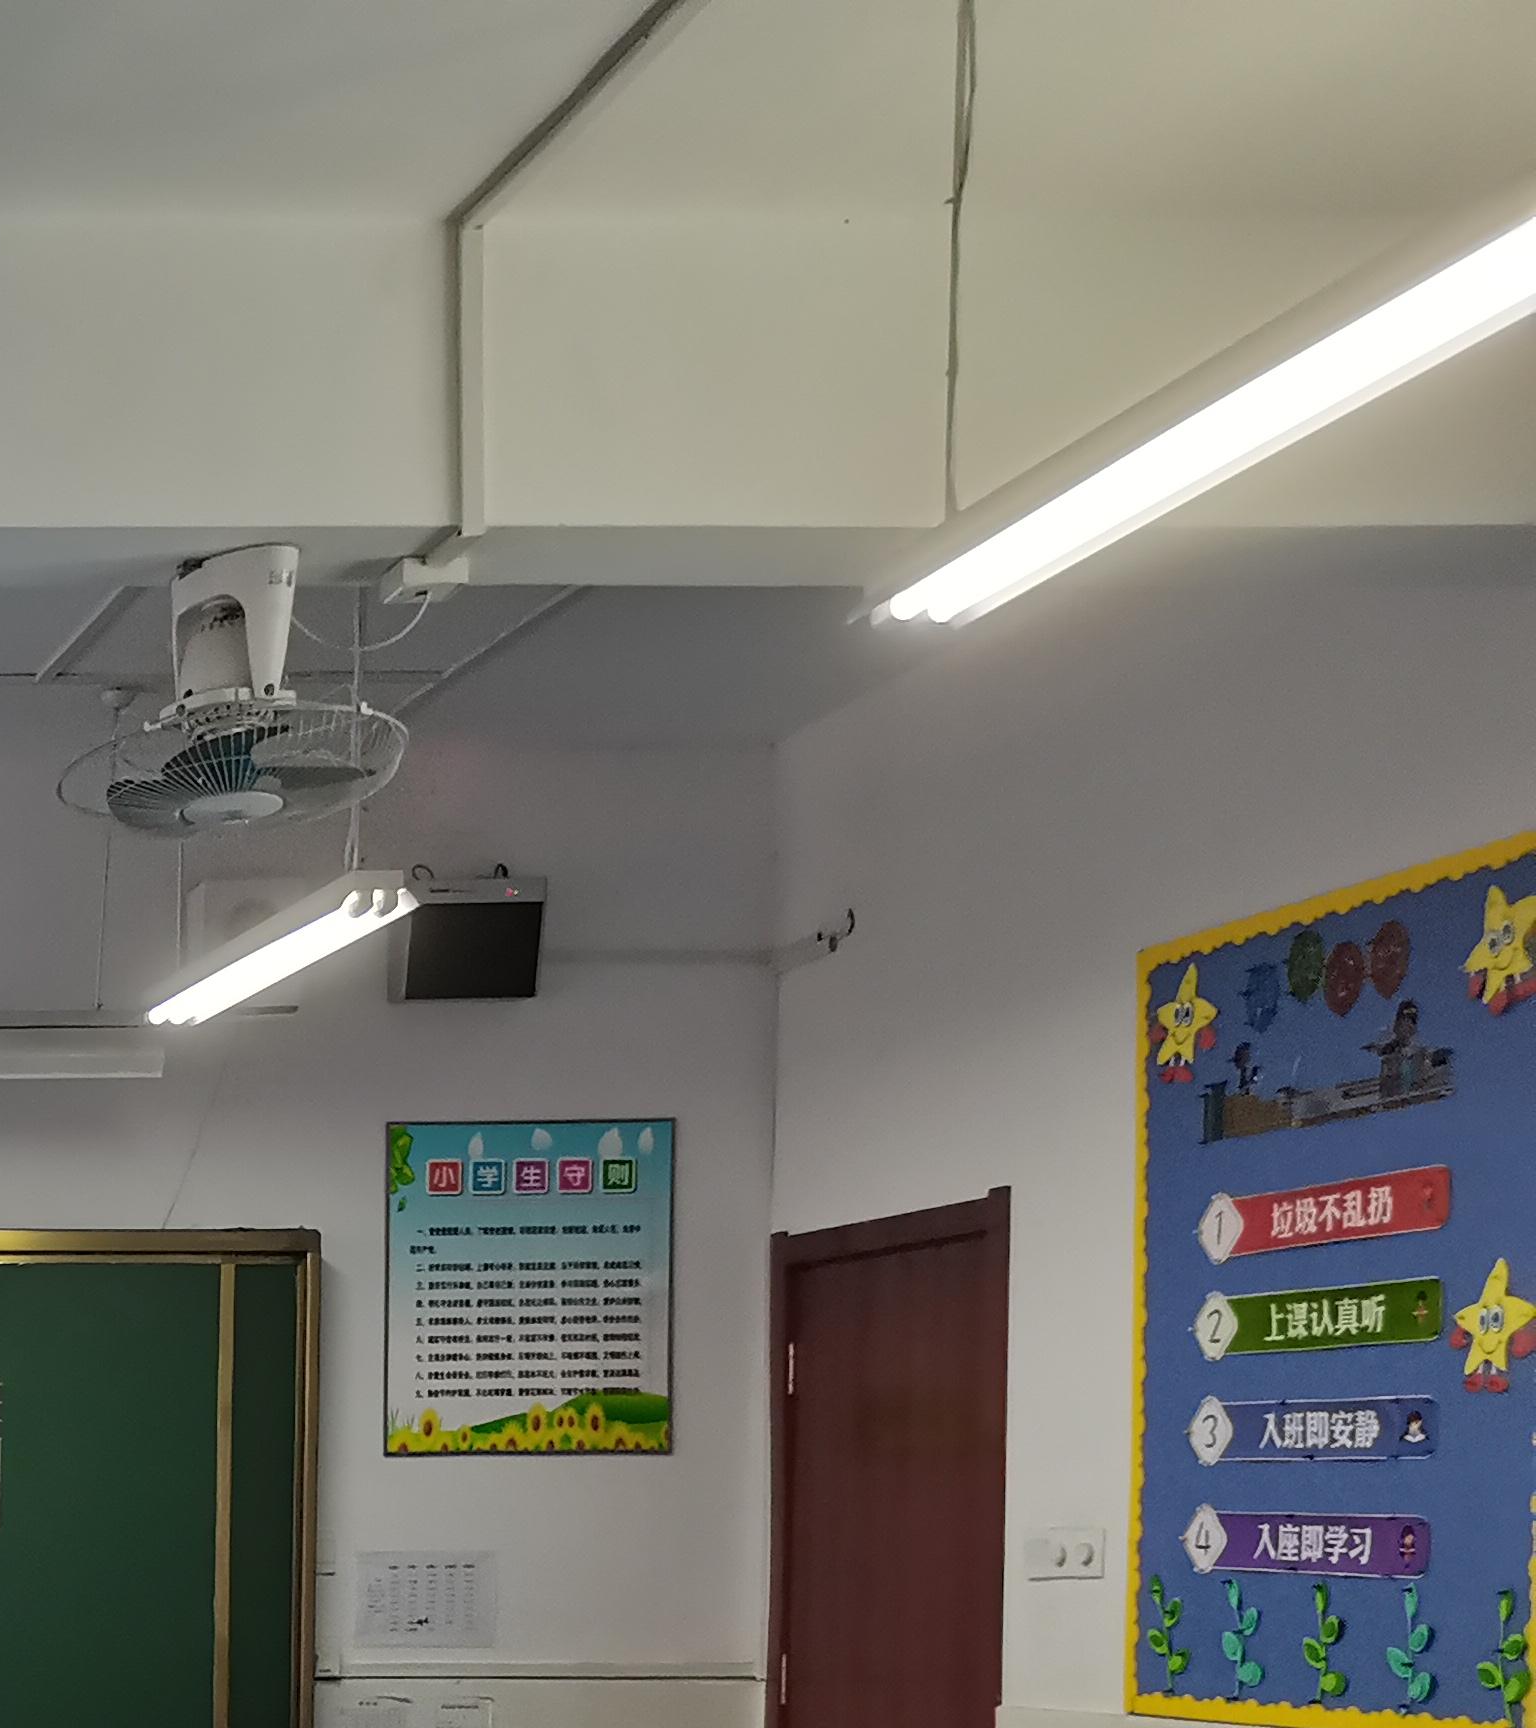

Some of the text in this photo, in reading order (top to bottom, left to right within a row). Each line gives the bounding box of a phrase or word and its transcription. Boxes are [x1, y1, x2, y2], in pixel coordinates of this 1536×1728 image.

[432, 1162, 630, 1188] 小学生守则
[1214, 1184, 1395, 1246] 1 垃圾不乱扔
[1206, 1294, 1387, 1344] 2 上课认真听
[1201, 1409, 1381, 1451] 3 入班即安静
[1194, 1520, 1374, 1565] 4 入座即学习
